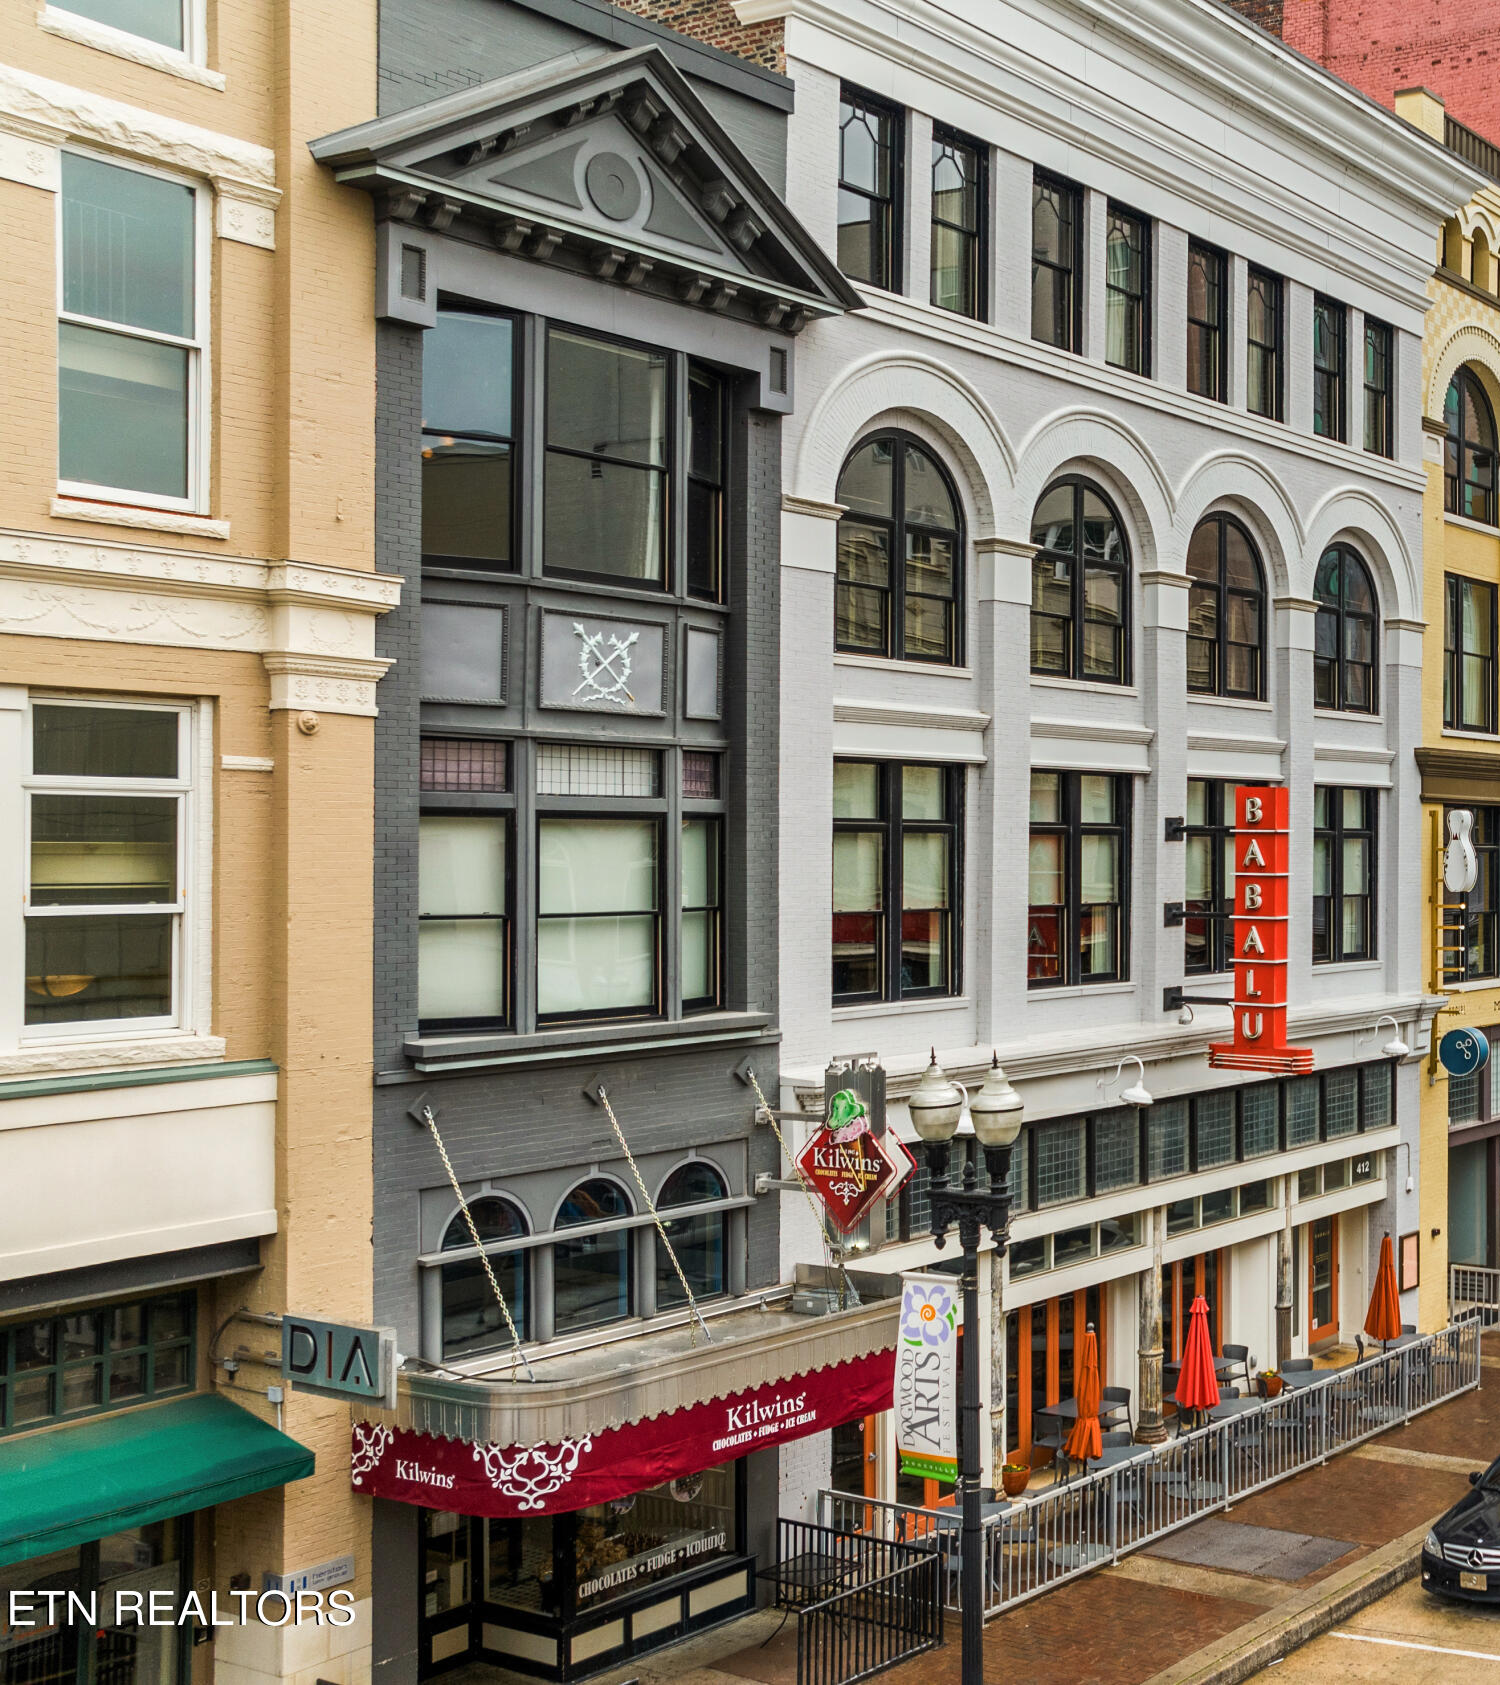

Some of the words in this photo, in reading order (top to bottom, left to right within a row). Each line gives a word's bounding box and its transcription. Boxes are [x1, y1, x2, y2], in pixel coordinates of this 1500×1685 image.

[1242, 797, 1266, 1040] BABALU
[813, 1147, 882, 1172] Kilwins
[1356, 1161, 1370, 1174] 412
[290, 1324, 374, 1387] DIA
[726, 1392, 806, 1432] Kilwins
[900, 1348, 915, 1447] DOGWOOD
[906, 1351, 941, 1450] ARTS
[942, 1352, 951, 1454] FESTIVAL
[712, 1430, 752, 1451] CHOCOLATES
[758, 1422, 779, 1437] FUDGE
[785, 1416, 795, 1428] ICE
[796, 1410, 816, 1425] CREAM
[395, 1460, 455, 1489] Kilwins
[578, 1564, 637, 1598] CHOCOLATES
[646, 1550, 676, 1573] FUDGE
